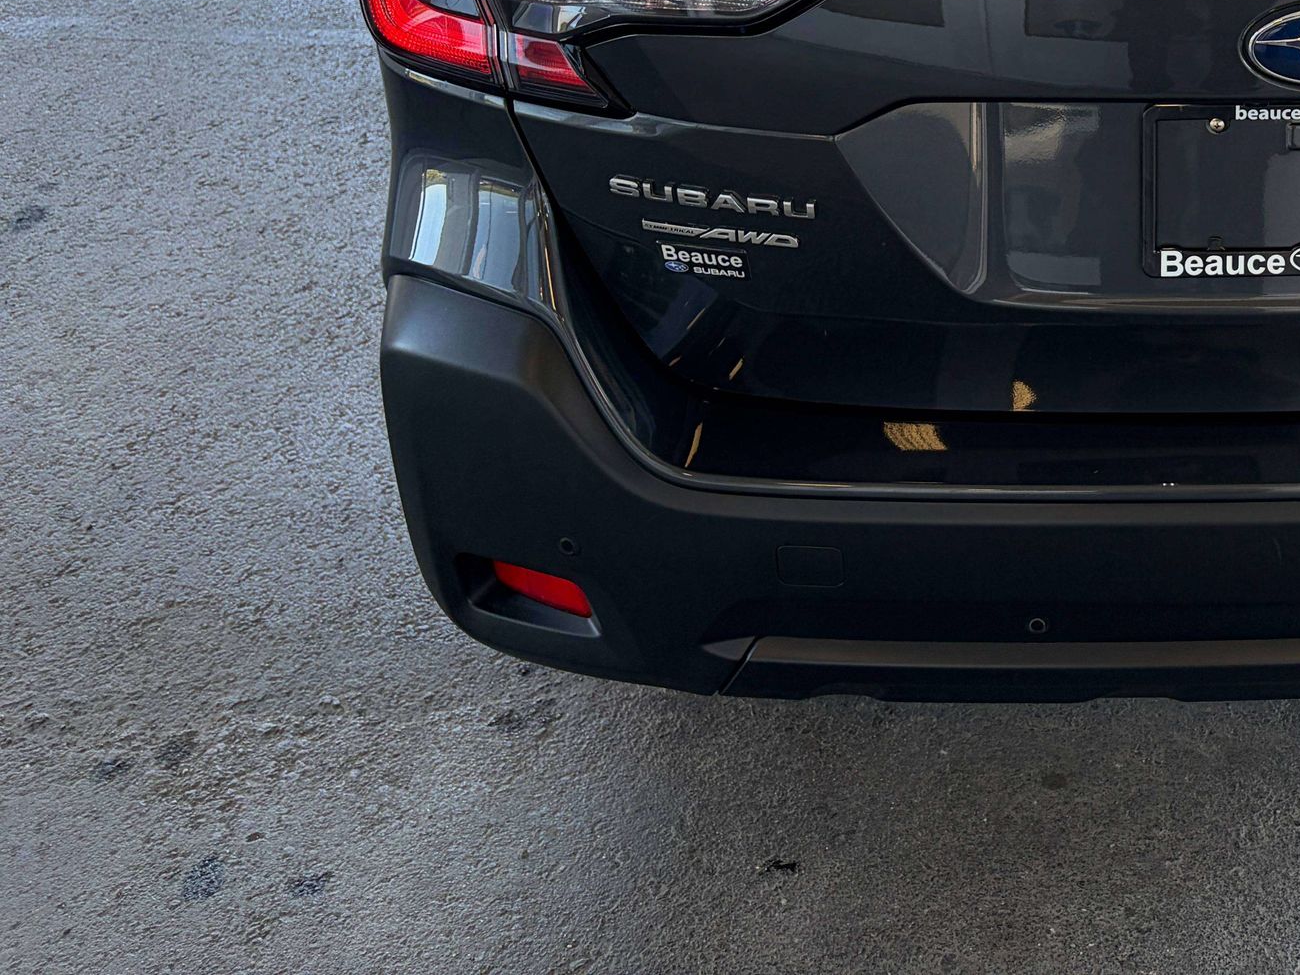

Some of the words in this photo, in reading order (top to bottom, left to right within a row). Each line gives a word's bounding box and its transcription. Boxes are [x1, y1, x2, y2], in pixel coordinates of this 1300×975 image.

[608, 174, 817, 220] SUBARU
[699, 227, 800, 249] AWD
[660, 243, 744, 268] Beauce
[1159, 249, 1286, 277] Beauce
[693, 265, 746, 279] SUBARU
